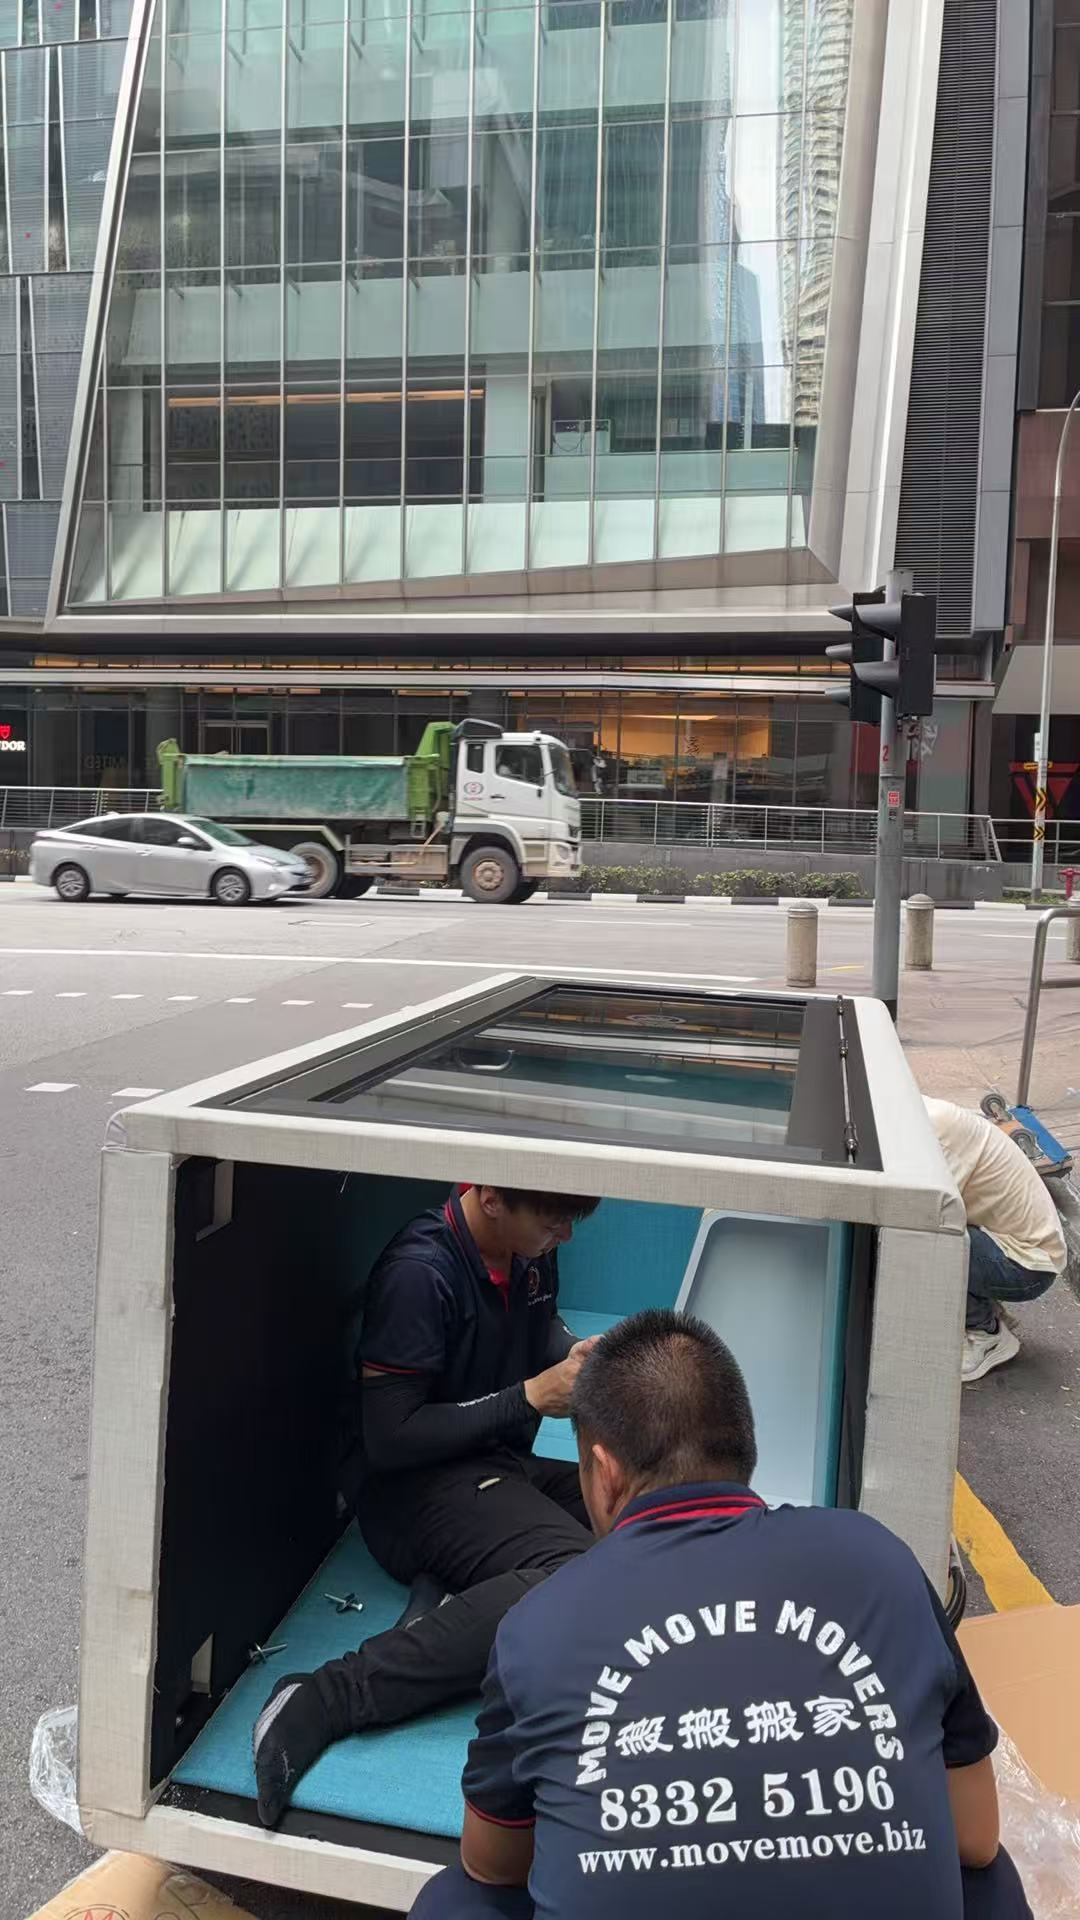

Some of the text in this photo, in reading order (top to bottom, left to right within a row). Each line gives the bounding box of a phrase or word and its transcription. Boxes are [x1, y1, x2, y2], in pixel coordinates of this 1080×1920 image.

[0, 740, 26, 751] DOR
[576, 1600, 905, 1786] MOVE MOVE MOVERS
[614, 1696, 862, 1757] 搬搬搬家
[600, 1766, 895, 1832] 8332 5196
[577, 1820, 927, 1874] www.movemove.biz
